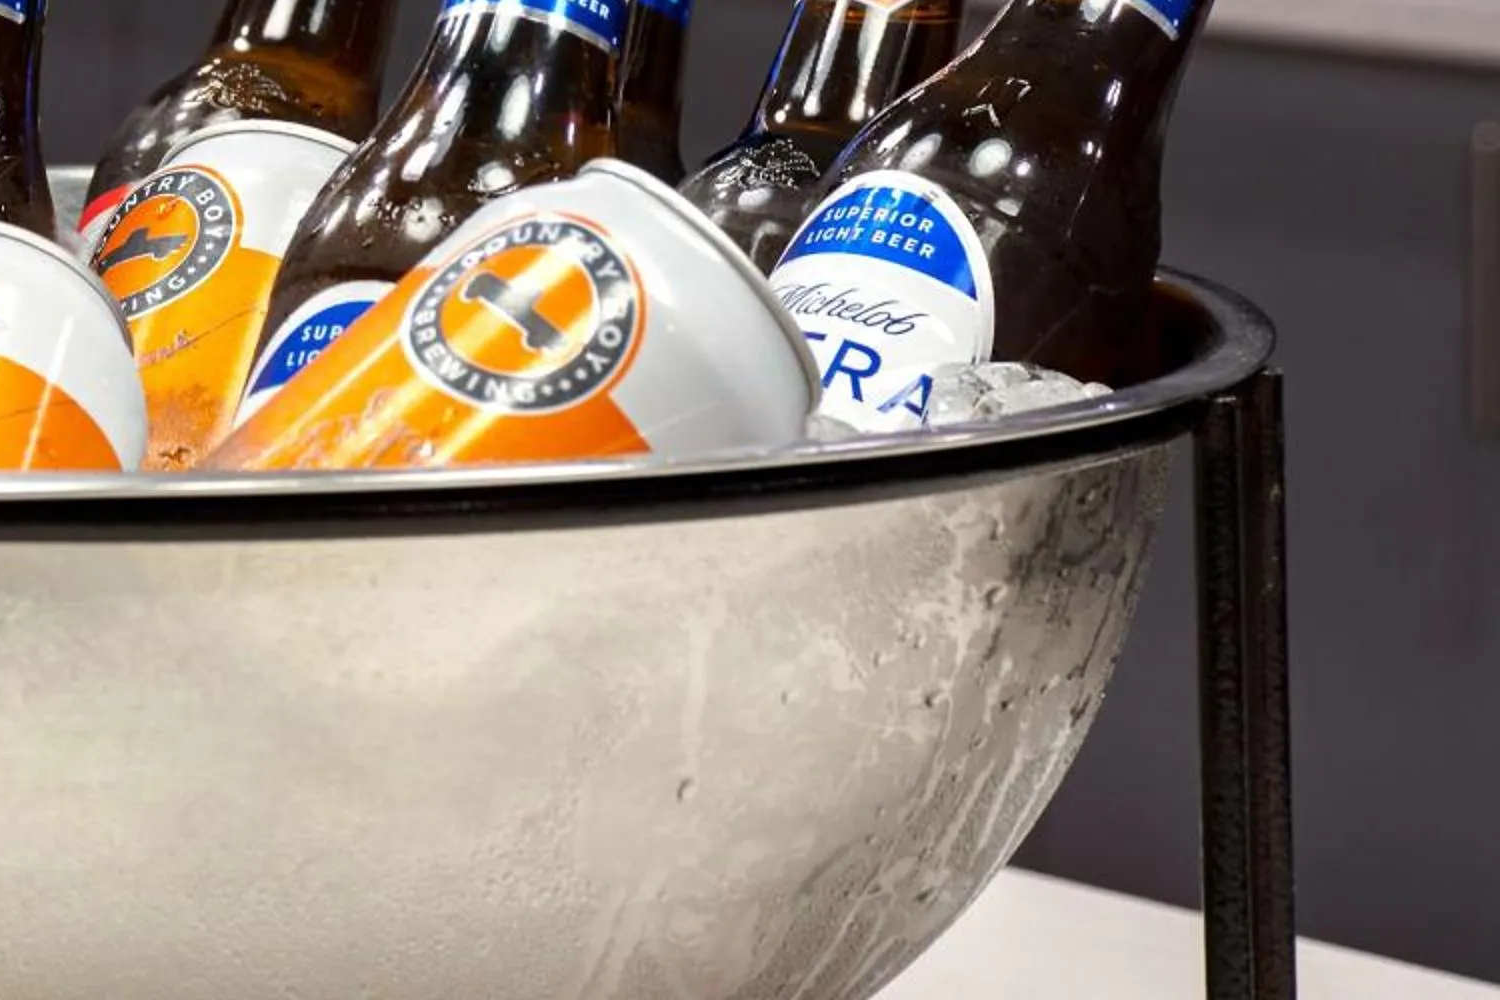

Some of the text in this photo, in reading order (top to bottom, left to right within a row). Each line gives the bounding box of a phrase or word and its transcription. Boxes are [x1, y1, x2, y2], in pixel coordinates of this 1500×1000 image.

[196, 187, 224, 239] BOY
[823, 205, 936, 234] SUPERIOR
[805, 226, 937, 260] LIGHT BEER
[598, 290, 626, 372] OY
[774, 282, 930, 336] Michelob
[411, 308, 537, 403] BREWING
